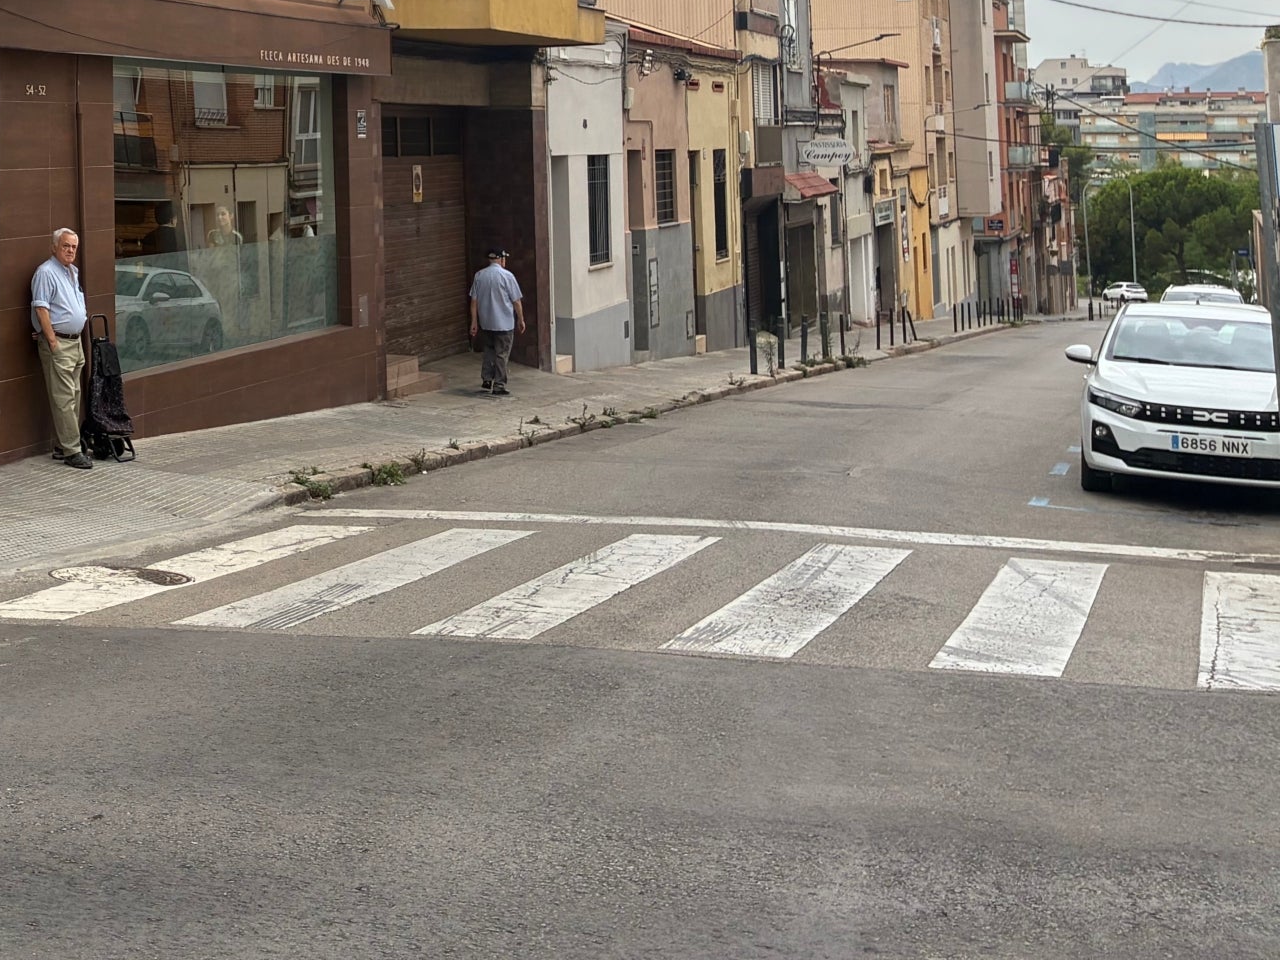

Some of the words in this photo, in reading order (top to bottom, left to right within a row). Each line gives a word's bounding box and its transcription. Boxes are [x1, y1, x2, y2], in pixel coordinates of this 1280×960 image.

[260, 50, 283, 61] FLECA
[287, 52, 323, 65] ARTESANA
[327, 55, 340, 66] DES
[343, 56, 351, 67] DE
[355, 58, 370, 68] 1948
[810, 141, 847, 149] PASTISSERIA
[803, 149, 852, 163] Campoy
[1181, 438, 1217, 451] 6856
[1222, 441, 1249, 454] NNX
